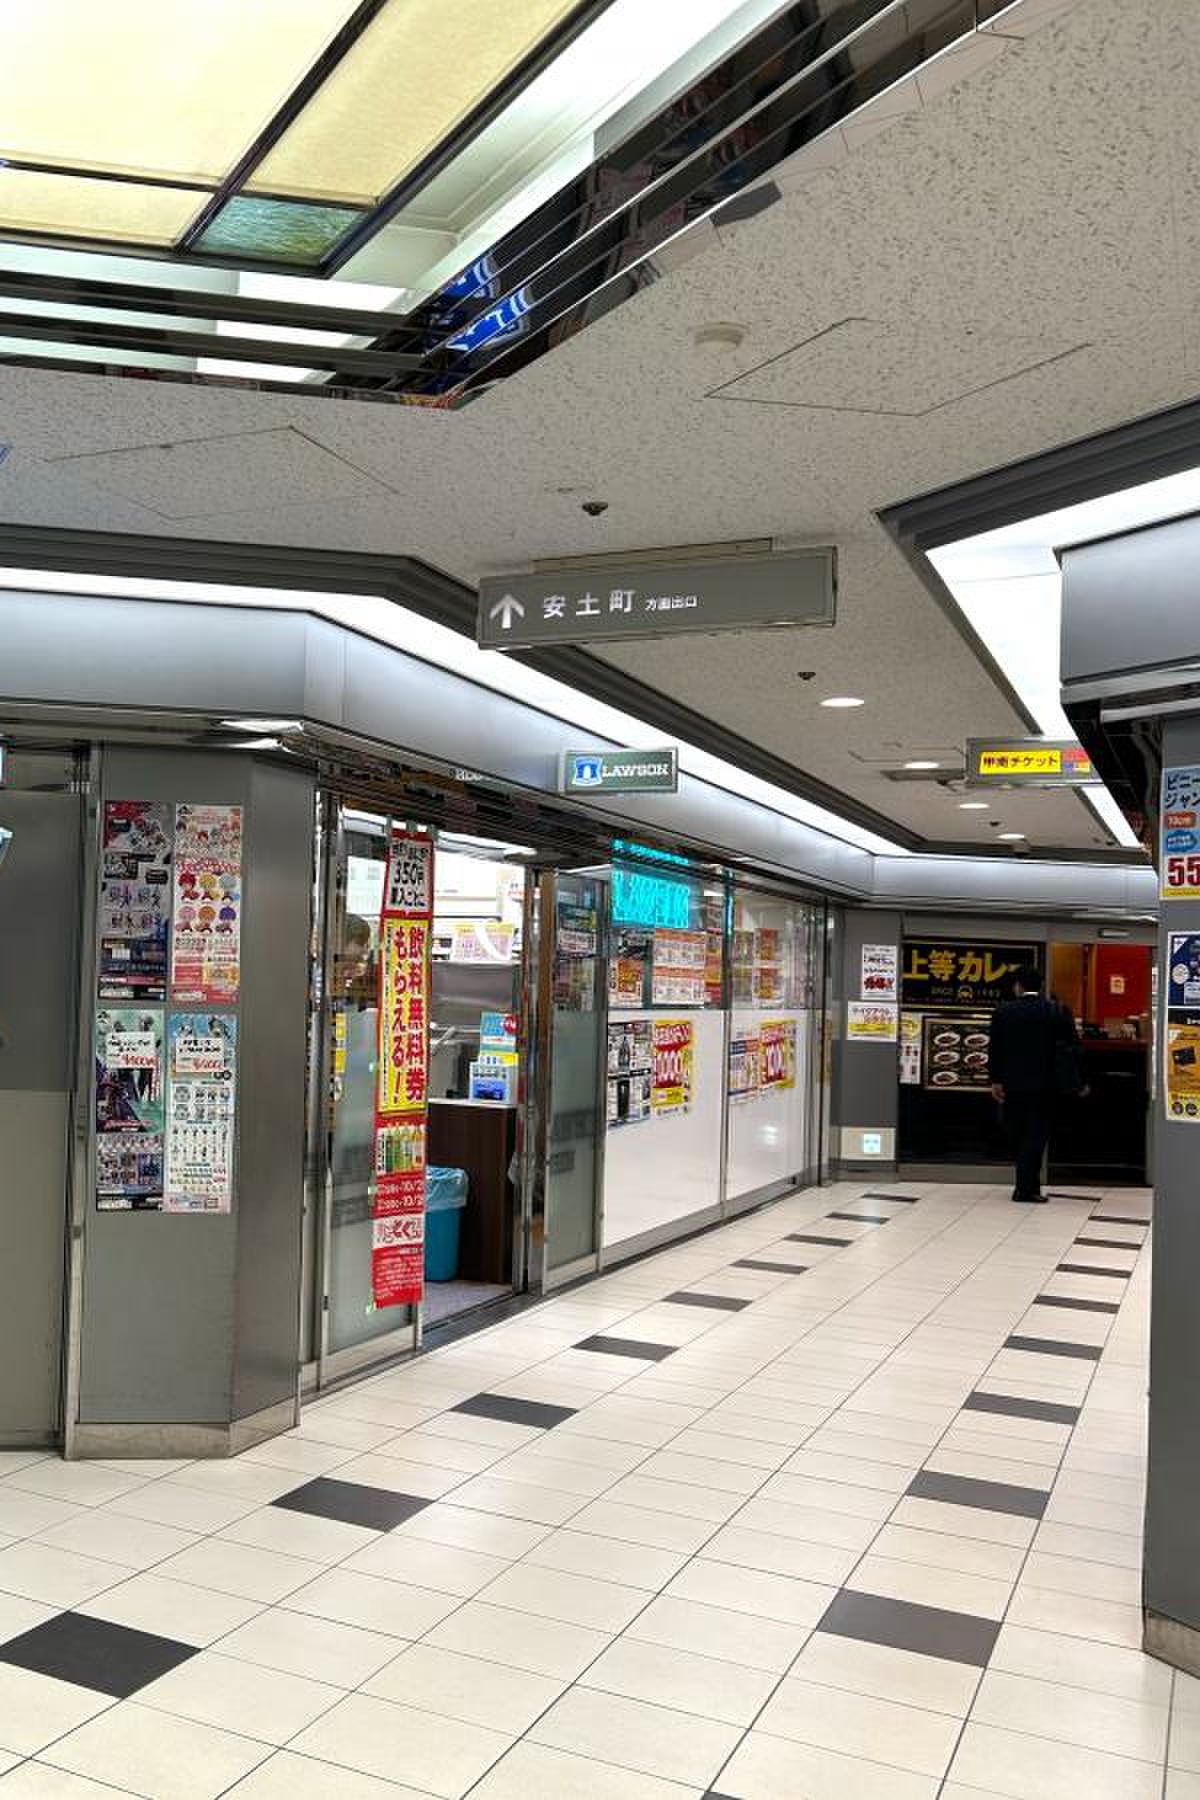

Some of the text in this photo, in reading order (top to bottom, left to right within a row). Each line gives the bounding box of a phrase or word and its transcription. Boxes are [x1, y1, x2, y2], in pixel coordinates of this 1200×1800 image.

[542, 589, 697, 618] 安土町 方面出口
[601, 762, 669, 779] LAWSON
